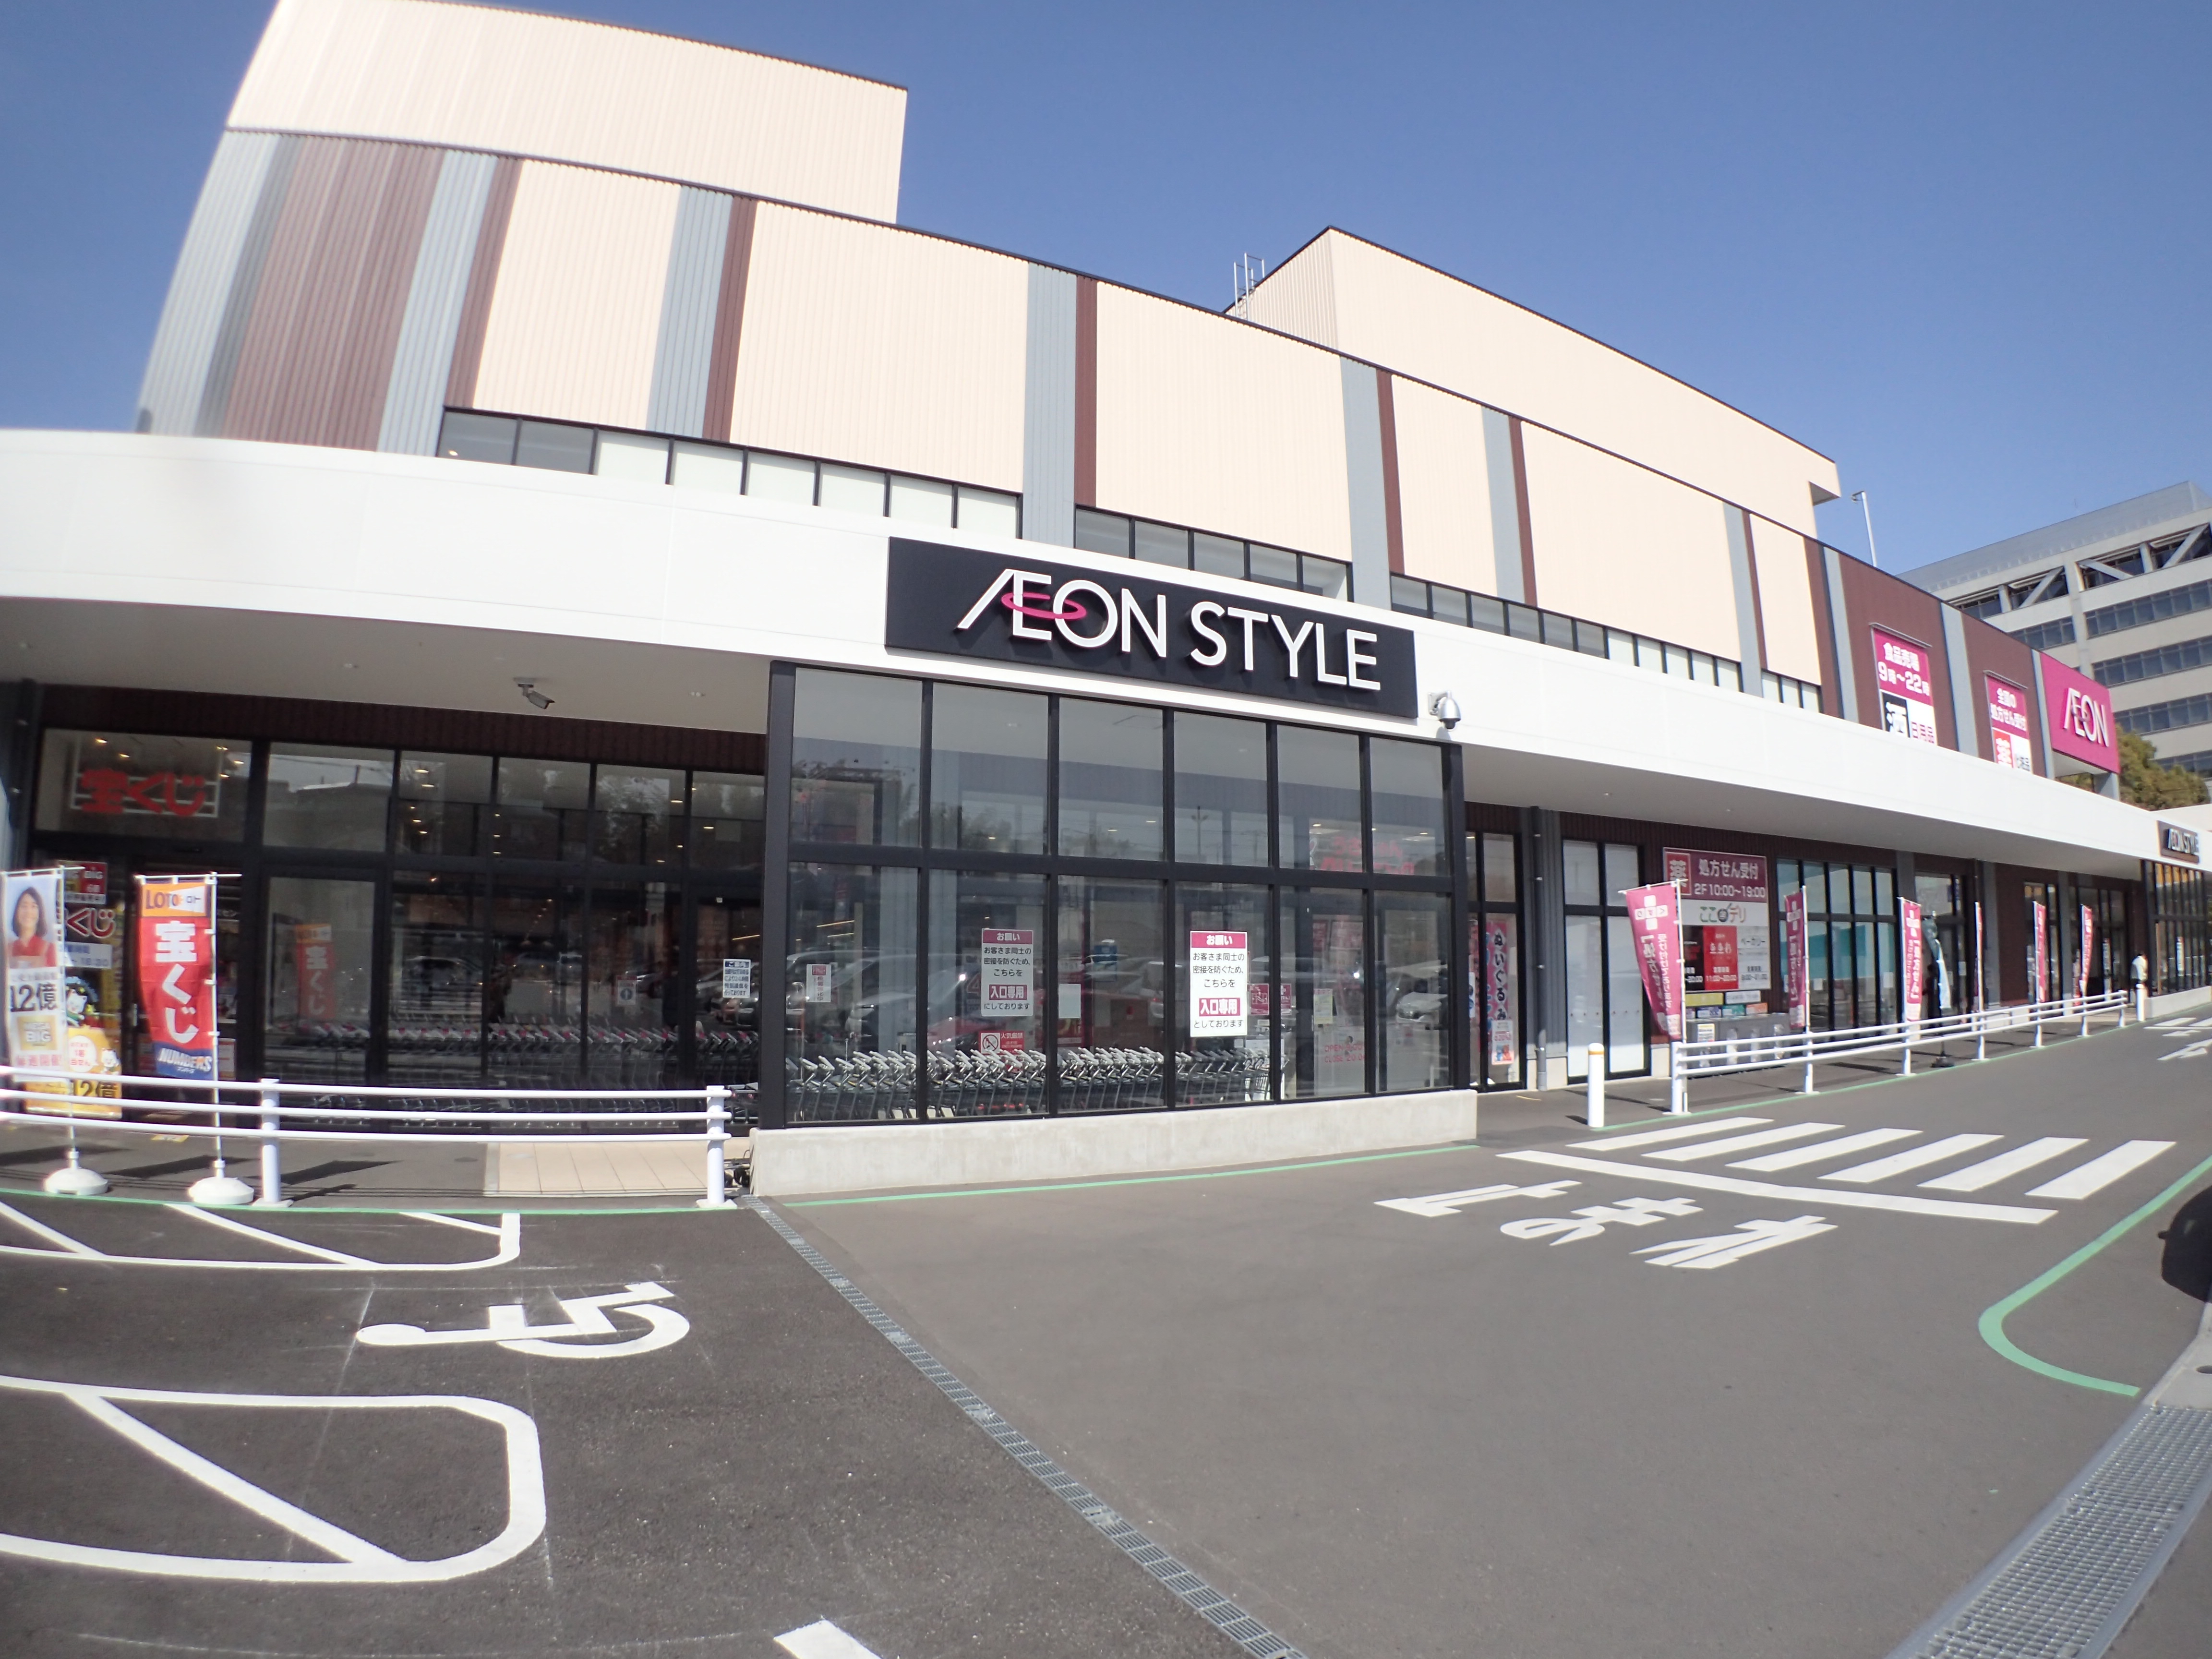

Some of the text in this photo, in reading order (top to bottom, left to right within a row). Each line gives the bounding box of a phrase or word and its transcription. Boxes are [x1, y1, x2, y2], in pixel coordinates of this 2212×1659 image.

[1190, 601, 1381, 690] STYLE
[1883, 642, 1919, 672] 食品売場
[81, 768, 206, 816] 宝くじ
[1698, 858, 1759, 879] 処方せん受付
[1694, 883, 1707, 895] 2F
[65, 908, 116, 938] くじ
[997, 932, 1020, 941] お願い
[1206, 935, 1232, 945] お願い
[1193, 952, 1244, 961] お客さま同士の
[156, 920, 199, 1044] 宝くじ
[991, 986, 1024, 998] 入口専用
[1204, 979, 1235, 987] こちらを
[11, 984, 58, 1011] 12億
[1201, 999, 1237, 1014] 入口専用
[26, 1031, 51, 1042] BIG
[157, 1048, 212, 1071] NUMBERS
[1374, 1180, 1838, 1269] 止まれ
